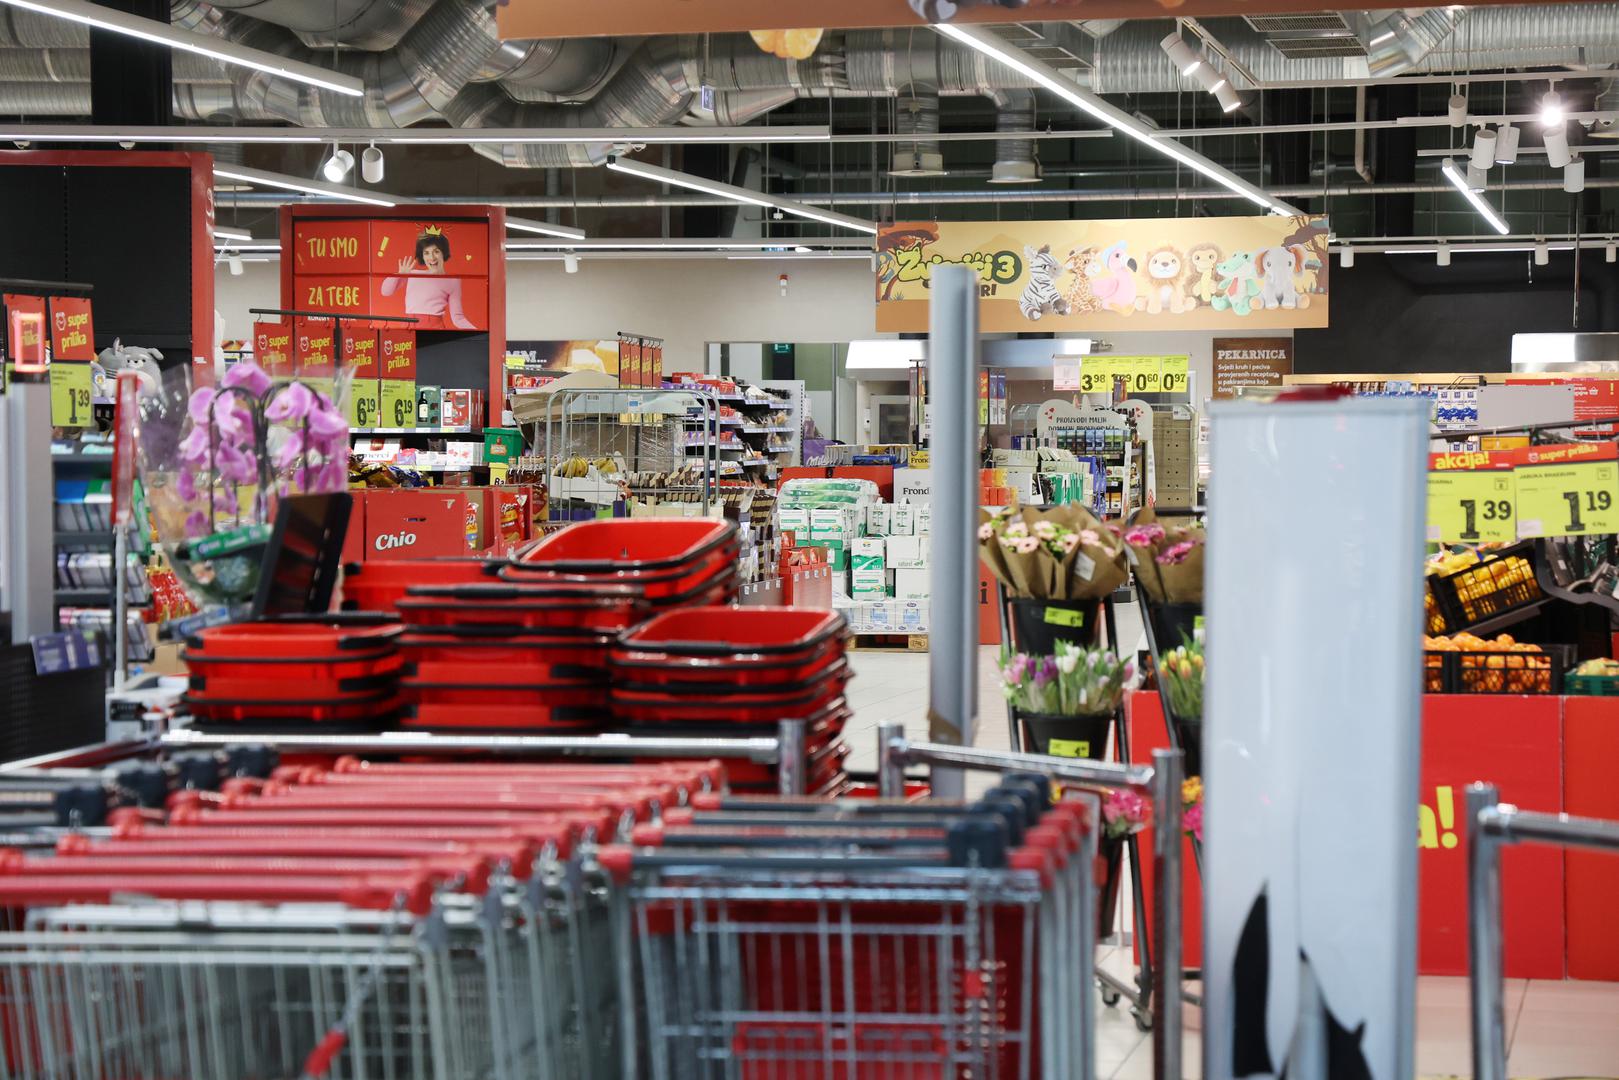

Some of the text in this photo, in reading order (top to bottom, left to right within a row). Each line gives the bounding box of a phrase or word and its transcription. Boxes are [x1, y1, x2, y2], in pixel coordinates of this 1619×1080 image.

[307, 238, 326, 257] TU
[330, 237, 358, 257] SMO
[996, 255, 1015, 279] 3
[308, 286, 360, 306] ZA TEBE
[67, 312, 89, 330] super
[61, 332, 87, 352] prilika
[268, 335, 289, 349] super
[310, 337, 331, 352] super
[355, 338, 375, 353] super
[393, 341, 413, 356] super
[304, 353, 328, 369] prilika
[387, 356, 410, 372] prilika
[1217, 350, 1286, 360] PEKARNICA
[1435, 451, 1490, 470] akcija!
[1539, 443, 1598, 461] super prilika
[375, 531, 417, 550] Chio
